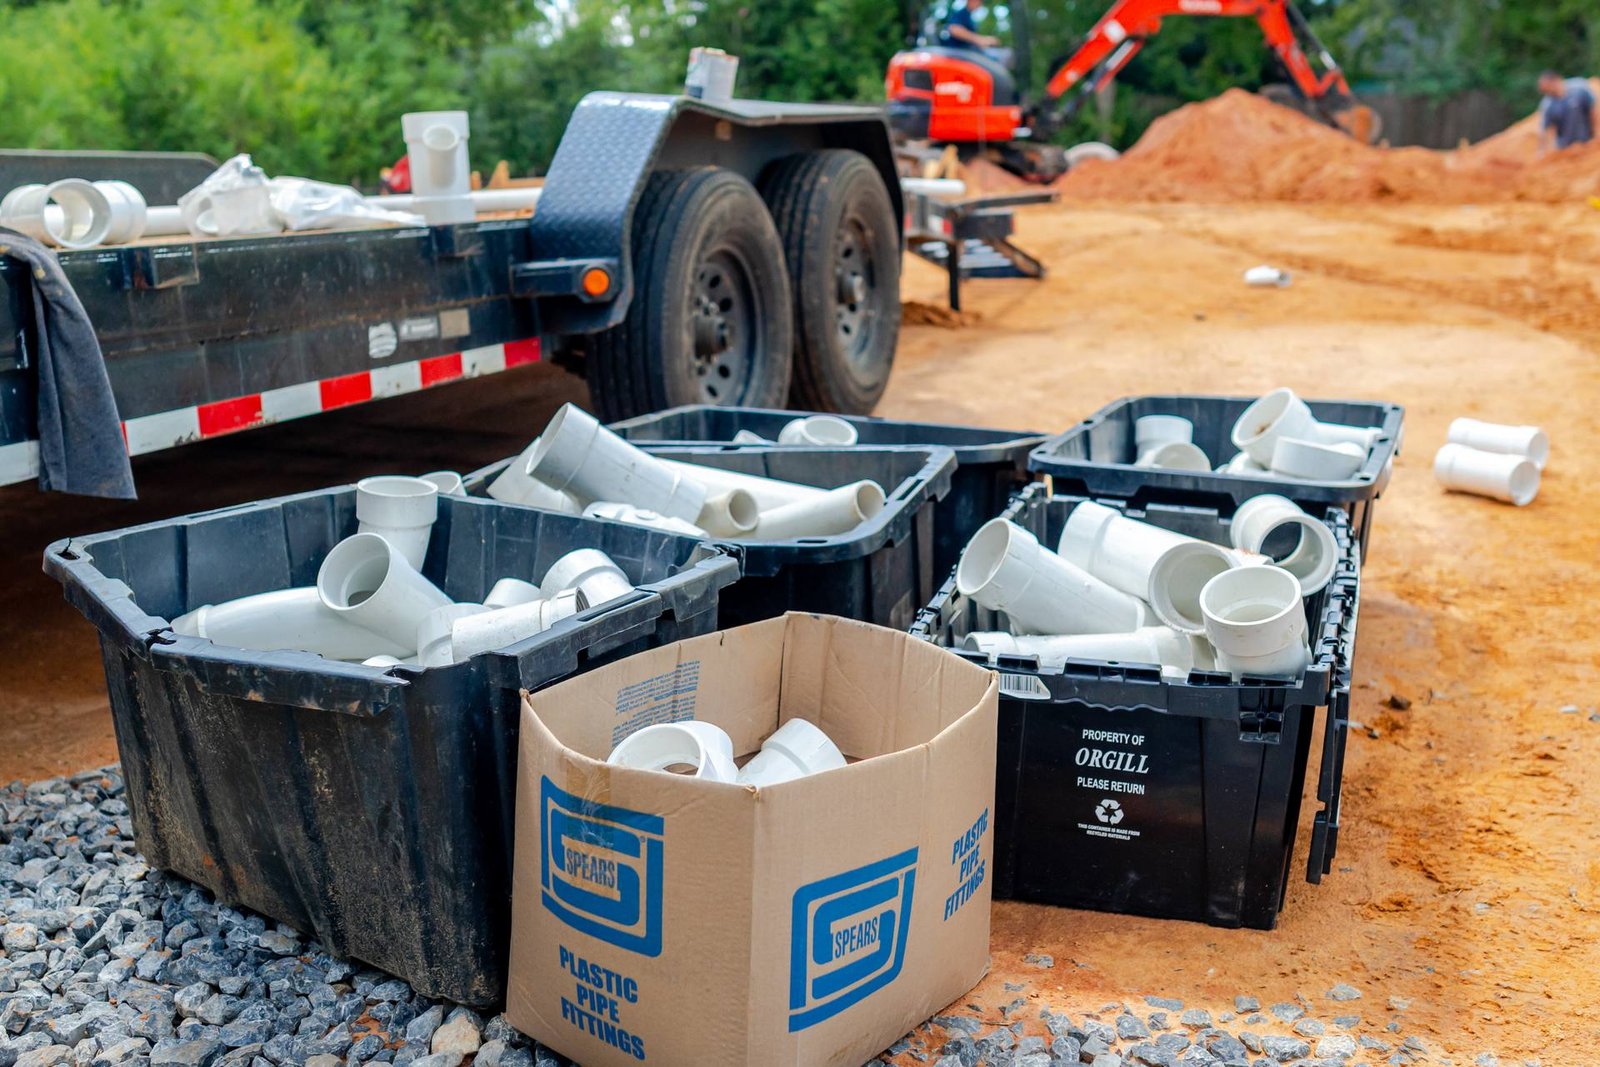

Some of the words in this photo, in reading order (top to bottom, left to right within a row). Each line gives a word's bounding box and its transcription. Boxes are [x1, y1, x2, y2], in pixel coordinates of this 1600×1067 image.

[1082, 729, 1130, 745] PROPERTY
[1131, 735, 1145, 746] OF
[1075, 747, 1149, 774] ORGILL
[1077, 776, 1109, 791] PLEASE
[1110, 781, 1145, 795] RETURN
[952, 807, 988, 865] PLASTIC
[566, 848, 615, 888] SPEARS
[959, 844, 979, 883] PIPE
[943, 859, 985, 921] FITTINGS
[835, 916, 877, 958] SPEARS
[559, 944, 638, 1003] PLASTIC
[576, 983, 620, 1023] PIPE
[561, 996, 645, 1060] FITTINGS
